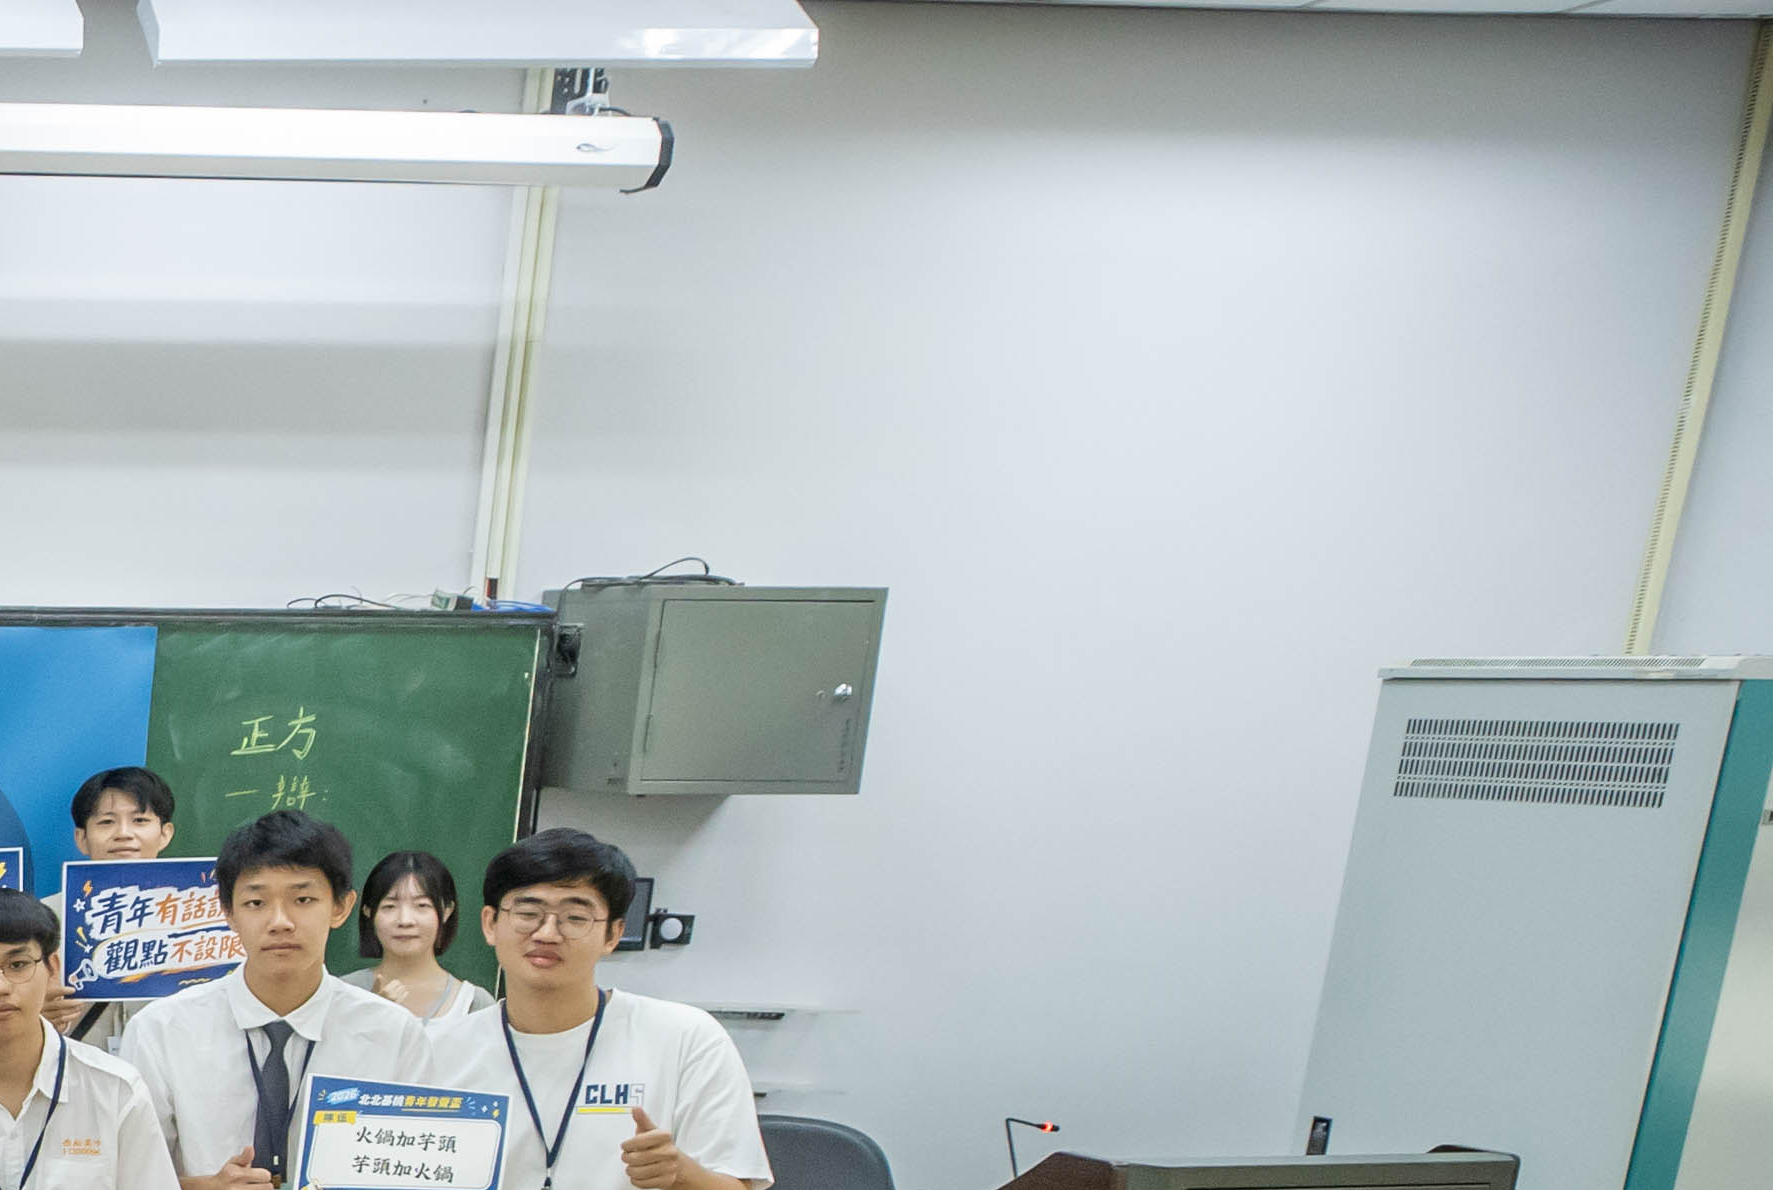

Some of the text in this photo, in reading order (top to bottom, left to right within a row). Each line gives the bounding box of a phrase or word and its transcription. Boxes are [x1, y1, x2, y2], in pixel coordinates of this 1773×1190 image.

[230, 705, 317, 760] 正方
[355, 1125, 457, 1153] 火鍋加芋頭
[351, 1155, 455, 1184] 芋頭加火鍋
